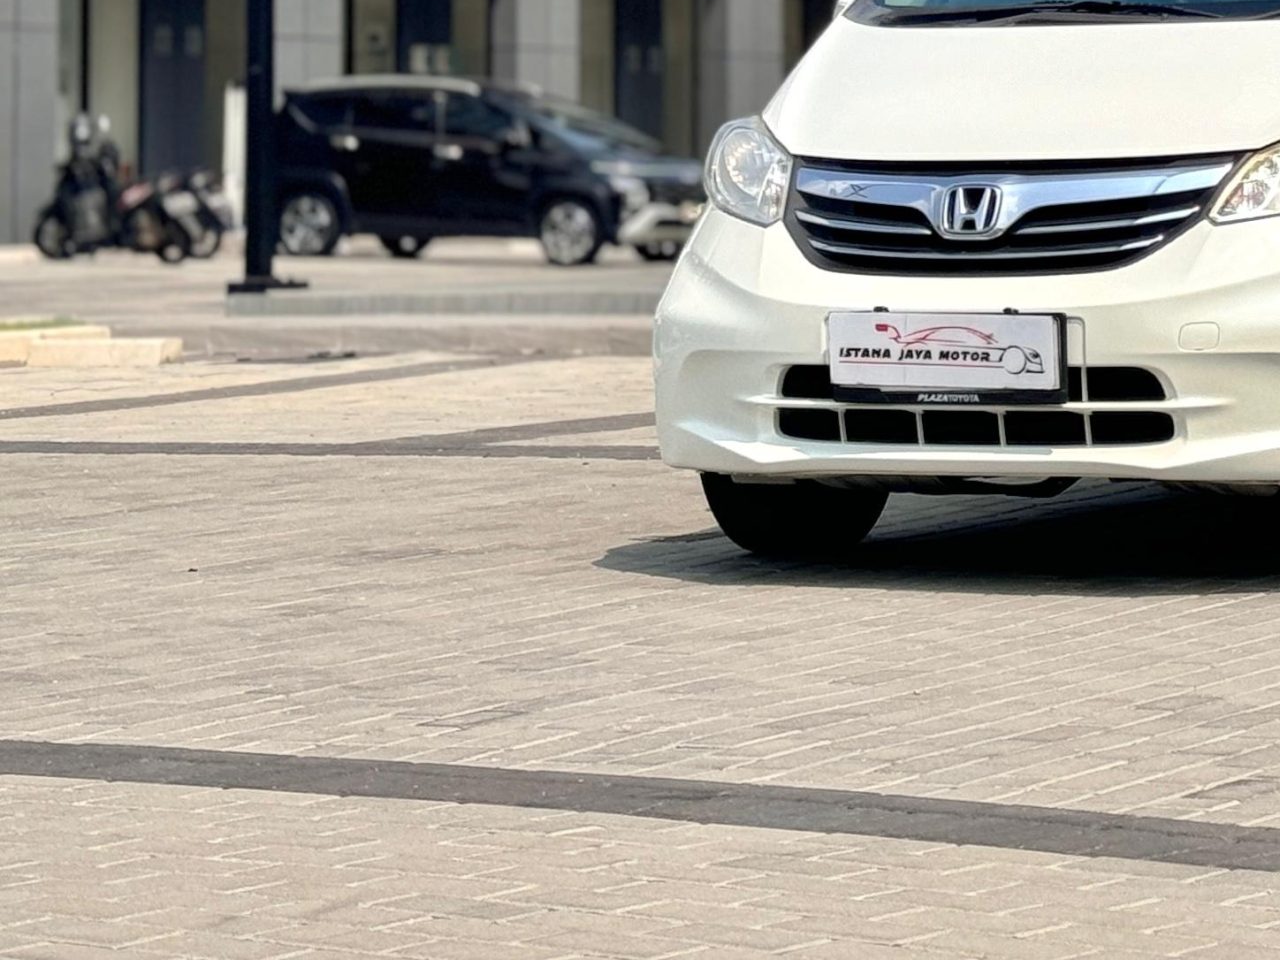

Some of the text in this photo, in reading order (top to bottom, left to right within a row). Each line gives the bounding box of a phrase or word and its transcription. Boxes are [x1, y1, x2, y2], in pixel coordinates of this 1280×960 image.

[839, 347, 991, 362] ISTANA JAYA MOTOR
